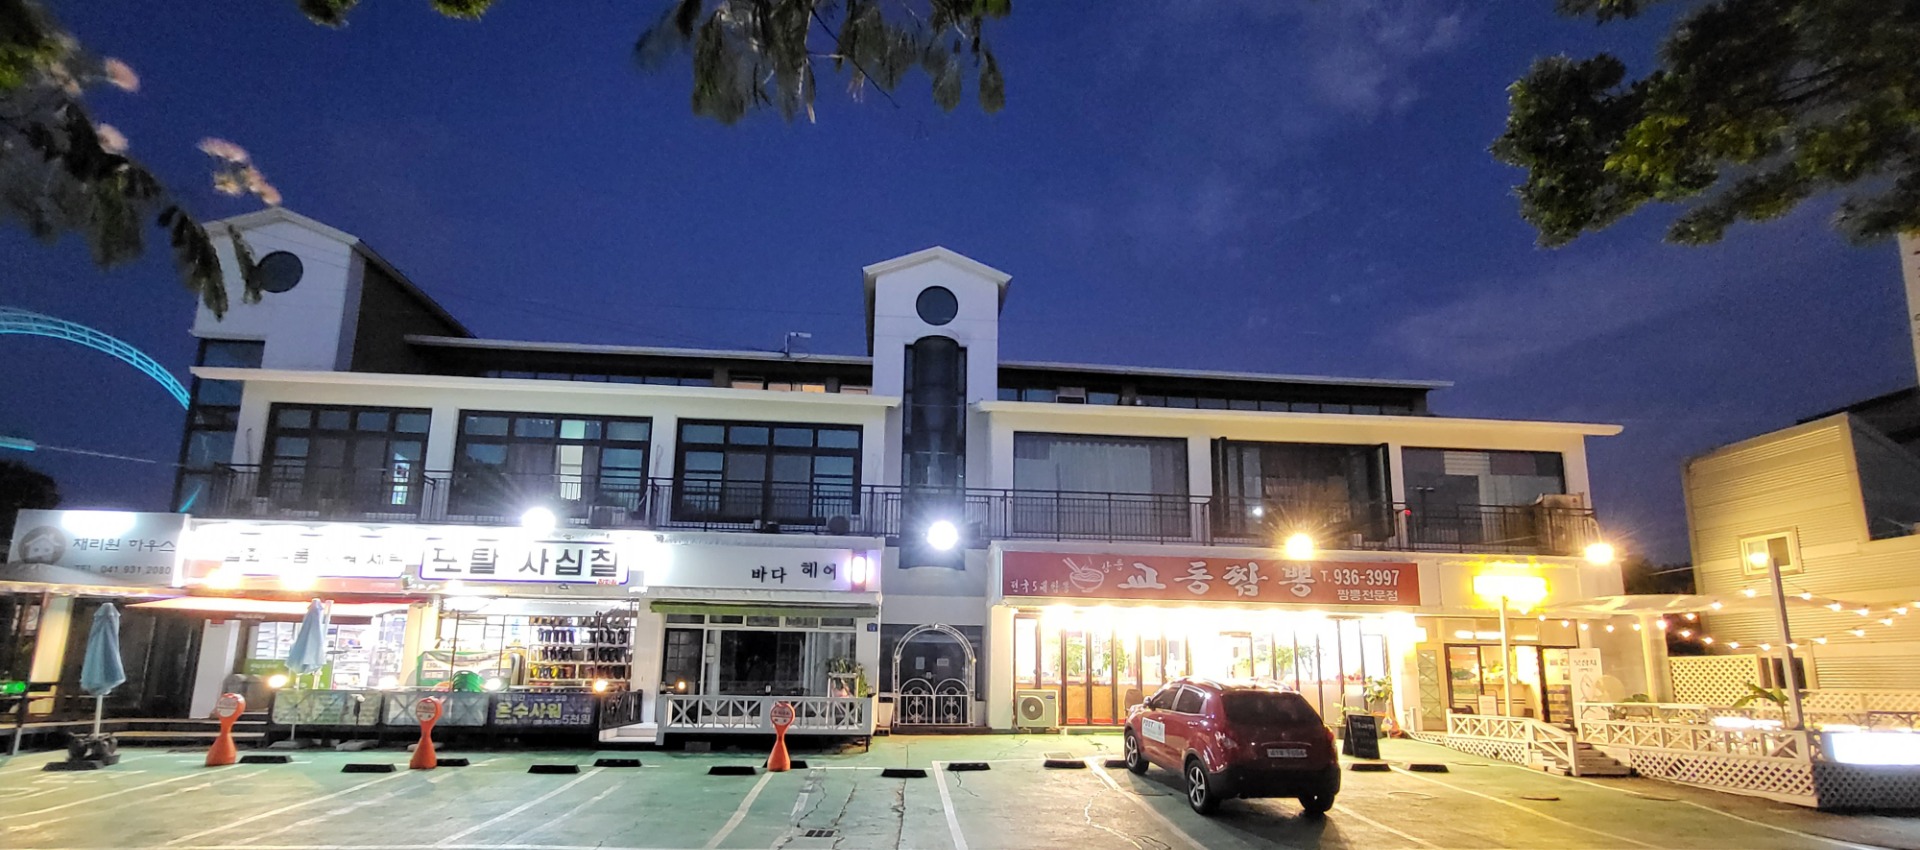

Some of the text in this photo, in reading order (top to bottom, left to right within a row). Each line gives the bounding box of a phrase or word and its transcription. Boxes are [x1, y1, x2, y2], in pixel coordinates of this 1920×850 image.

[129, 539, 175, 551] 하우스
[101, 565, 117, 574] 041
[124, 565, 141, 574] 931
[146, 566, 171, 574] 2080
[518, 548, 618, 578] 사십칠
[751, 561, 836, 584] 바다 헤어
